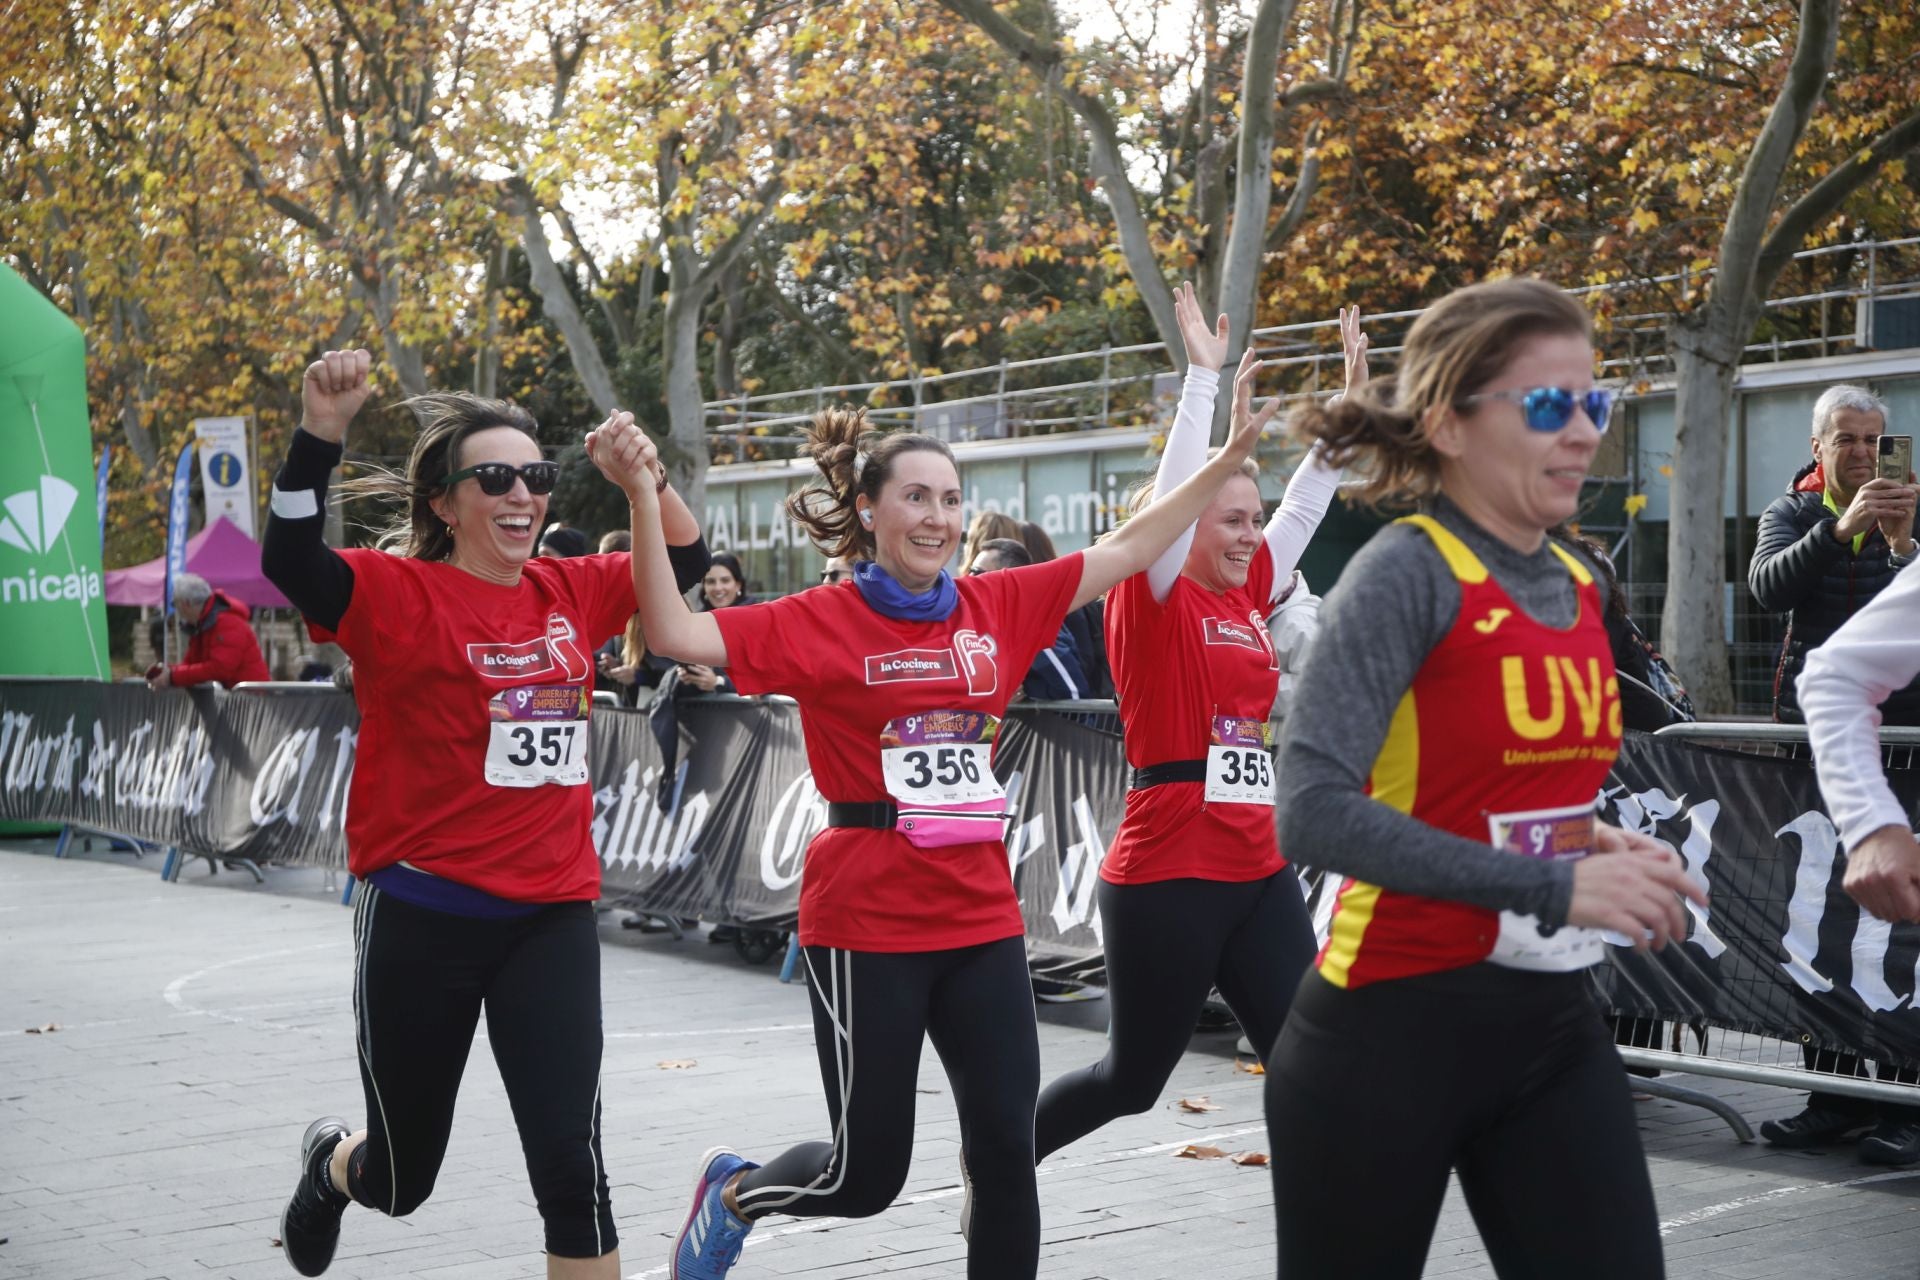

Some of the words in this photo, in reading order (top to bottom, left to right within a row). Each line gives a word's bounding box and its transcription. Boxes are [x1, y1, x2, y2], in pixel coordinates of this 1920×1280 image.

[1042, 474, 1129, 535] ami
[2, 564, 100, 609] nicaja
[483, 653, 496, 665] la
[880, 662, 893, 672] la
[892, 657, 941, 670] Cocinera
[507, 726, 576, 767] 357
[902, 748, 980, 789] 356
[1220, 750, 1270, 788] 355
